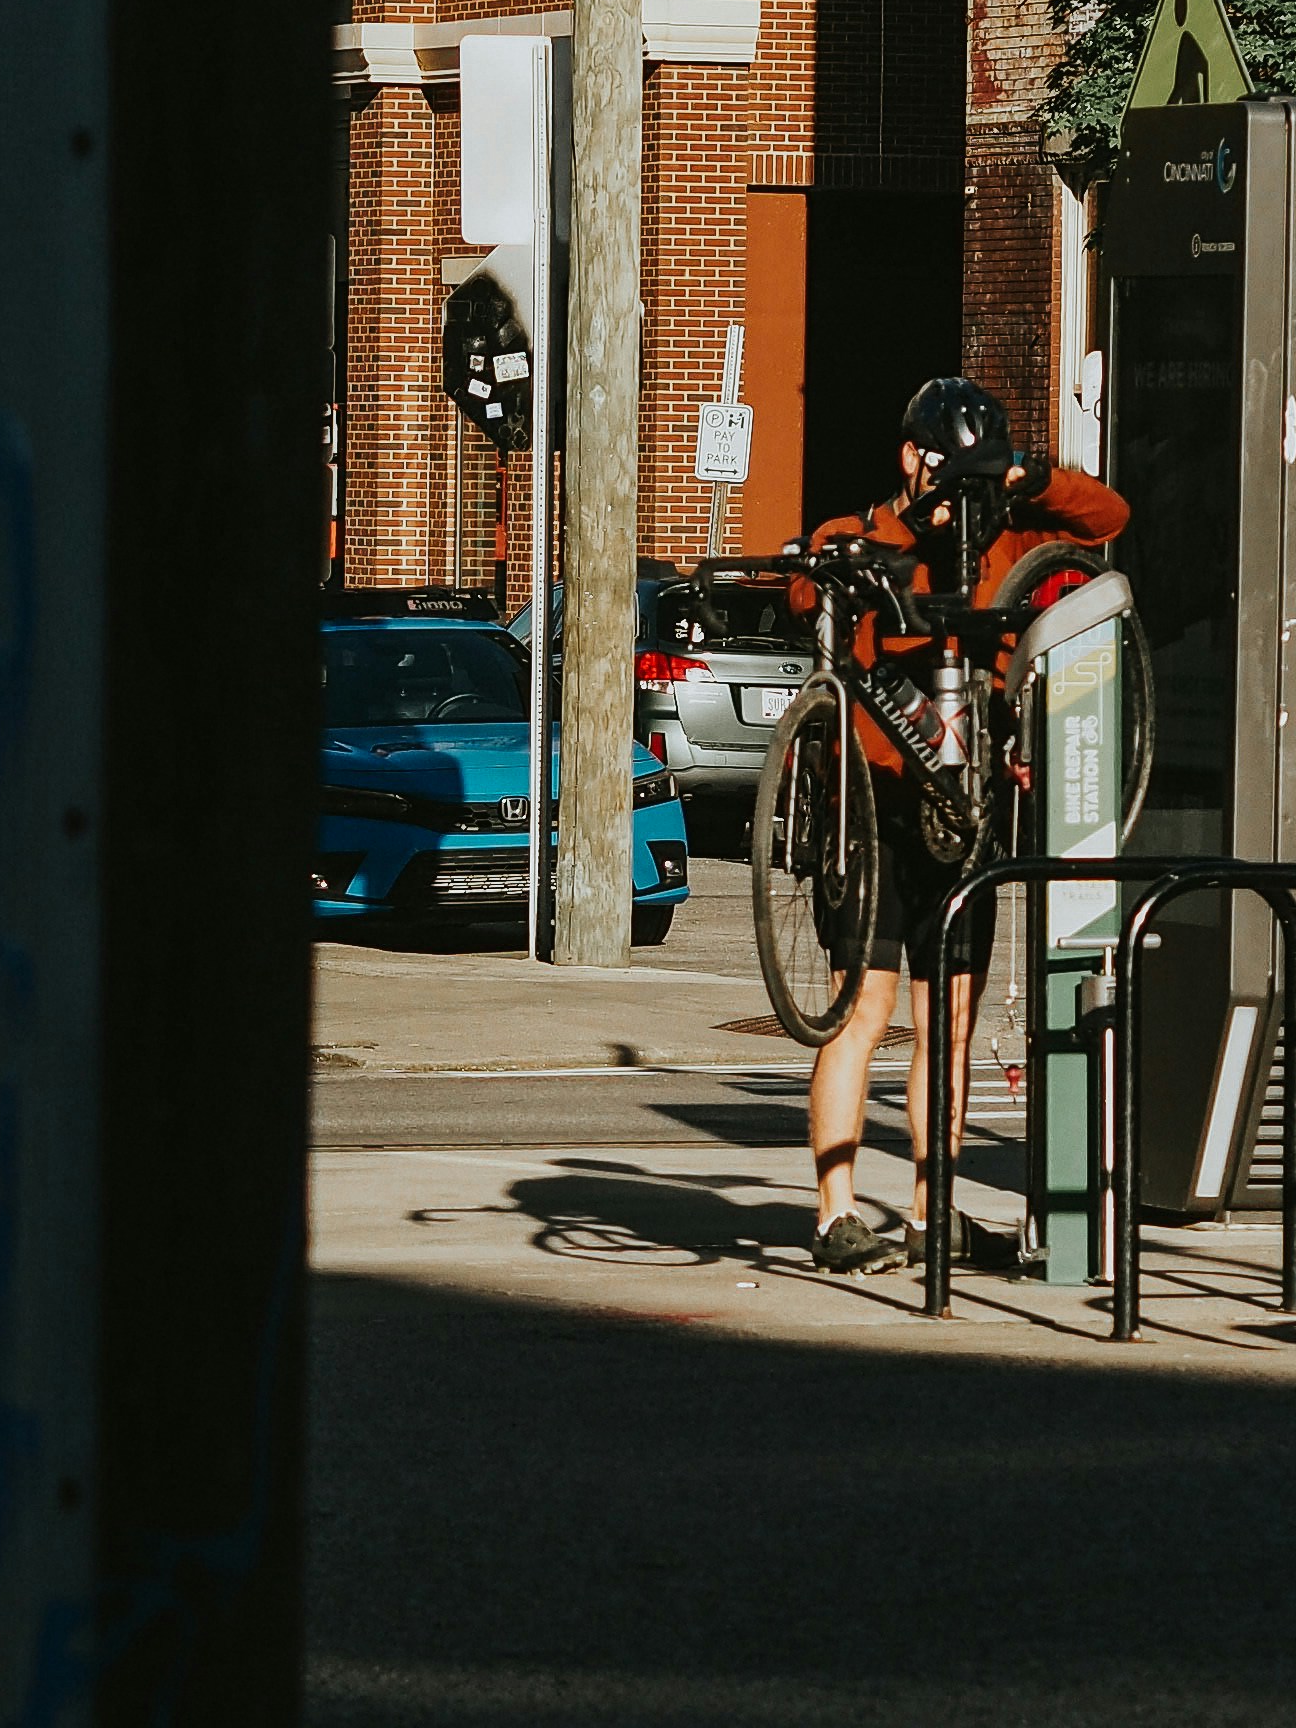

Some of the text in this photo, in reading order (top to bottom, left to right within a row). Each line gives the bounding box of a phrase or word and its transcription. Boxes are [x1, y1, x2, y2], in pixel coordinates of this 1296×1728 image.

[1164, 161, 1213, 182] CINCINNATI
[713, 430, 736, 442] PAY
[717, 442, 731, 453] TO
[706, 453, 738, 465] PARK
[1065, 715, 1081, 824] BIKE REPAIR
[1083, 749, 1100, 824] STATION
